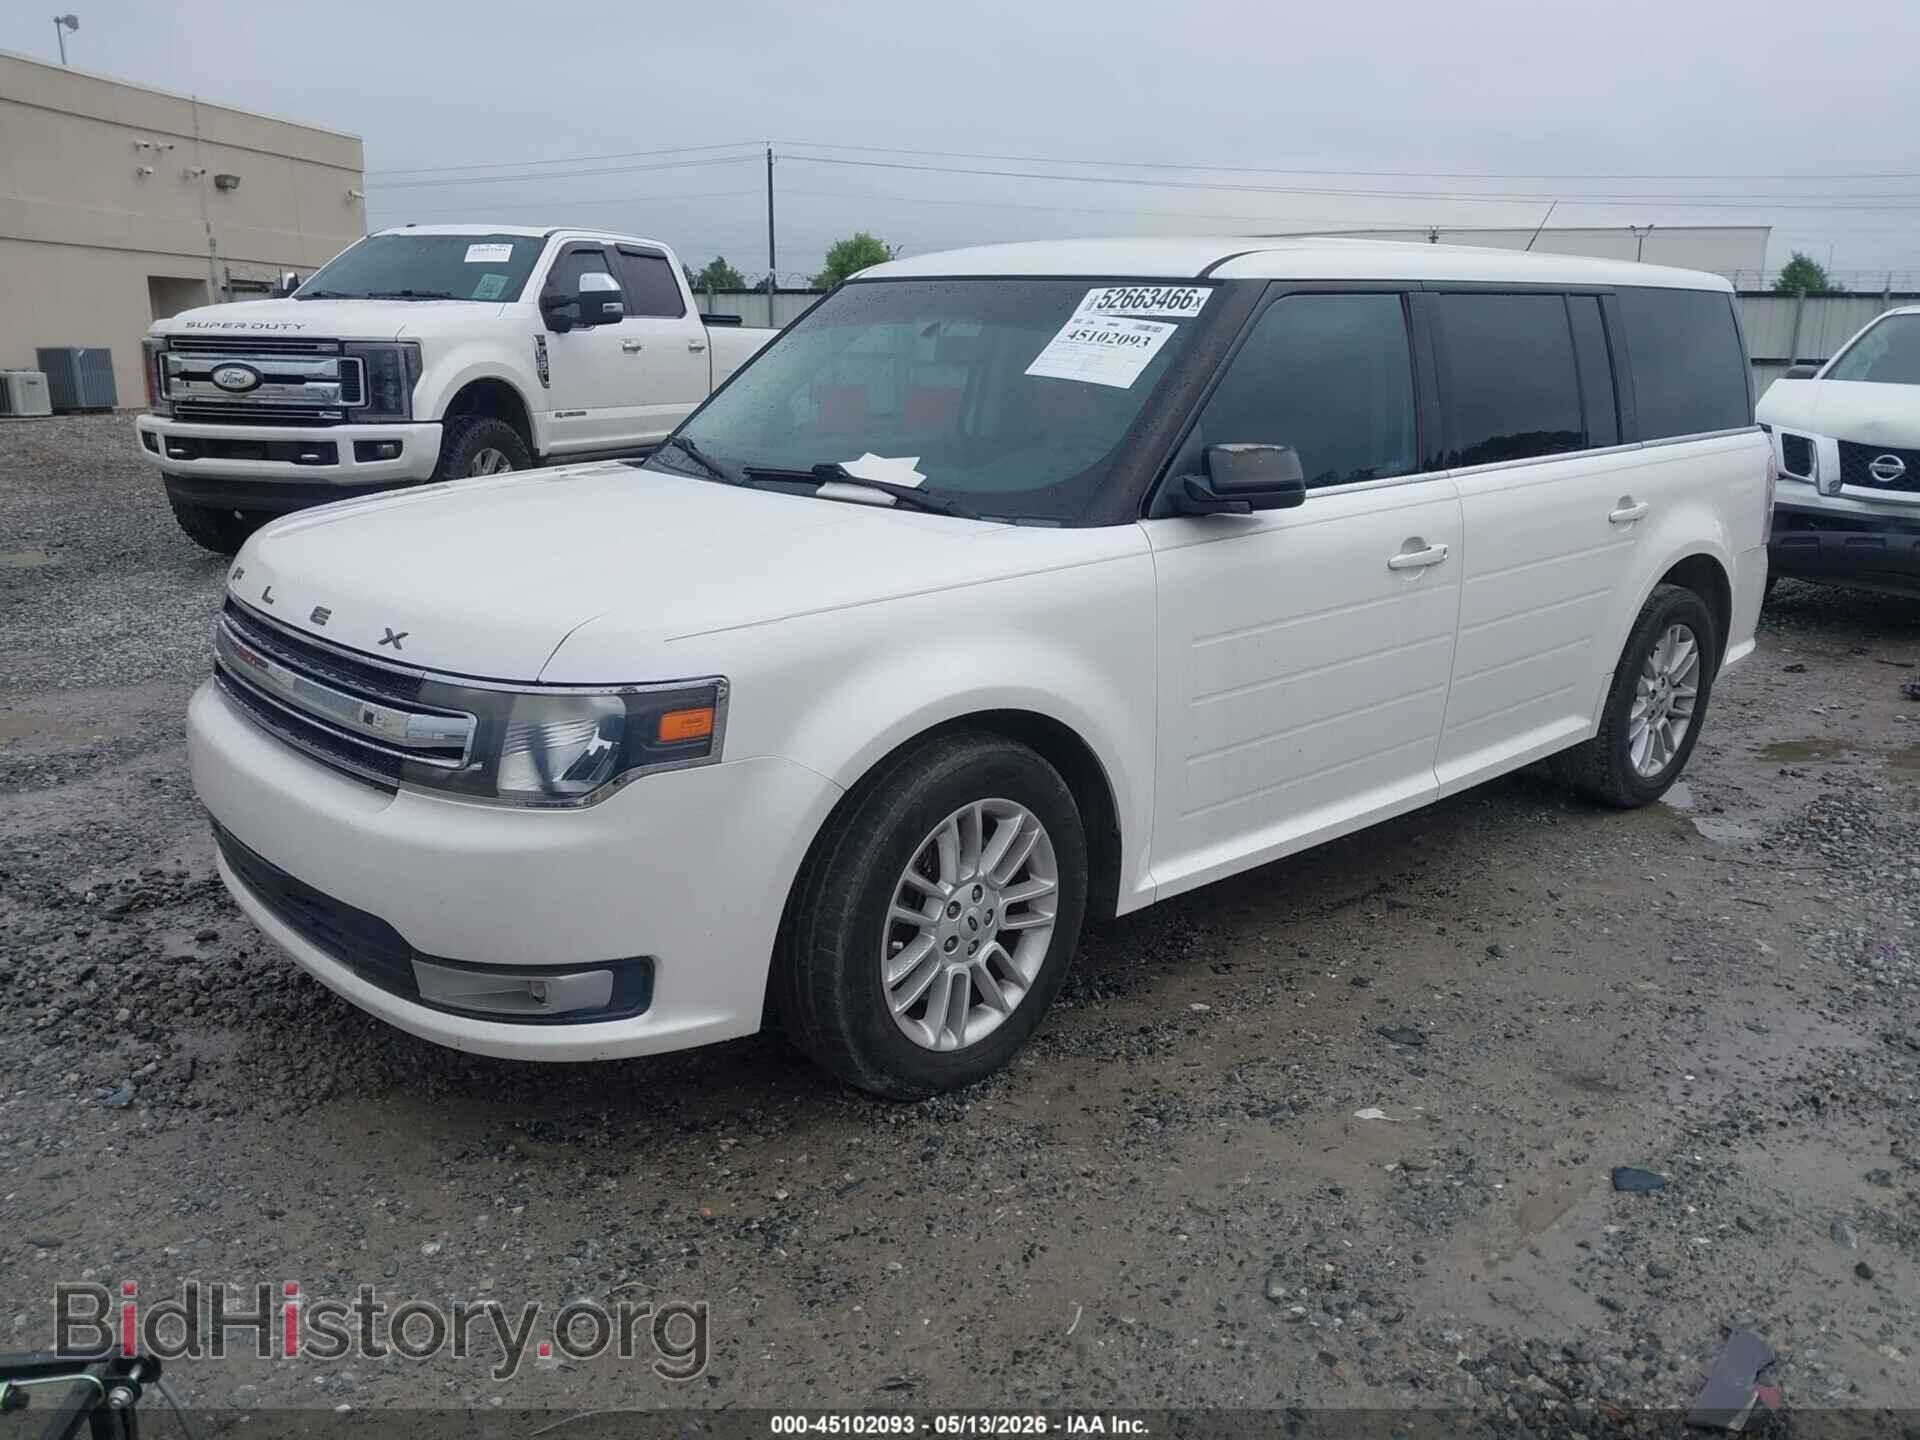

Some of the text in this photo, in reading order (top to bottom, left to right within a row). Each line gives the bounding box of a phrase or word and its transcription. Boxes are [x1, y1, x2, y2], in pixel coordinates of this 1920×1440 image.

[1096, 287, 1198, 310] 52663466
[184, 320, 306, 331] SUPER DUTY
[1066, 328, 1153, 349] 45102093
[221, 369, 248, 385] Ford
